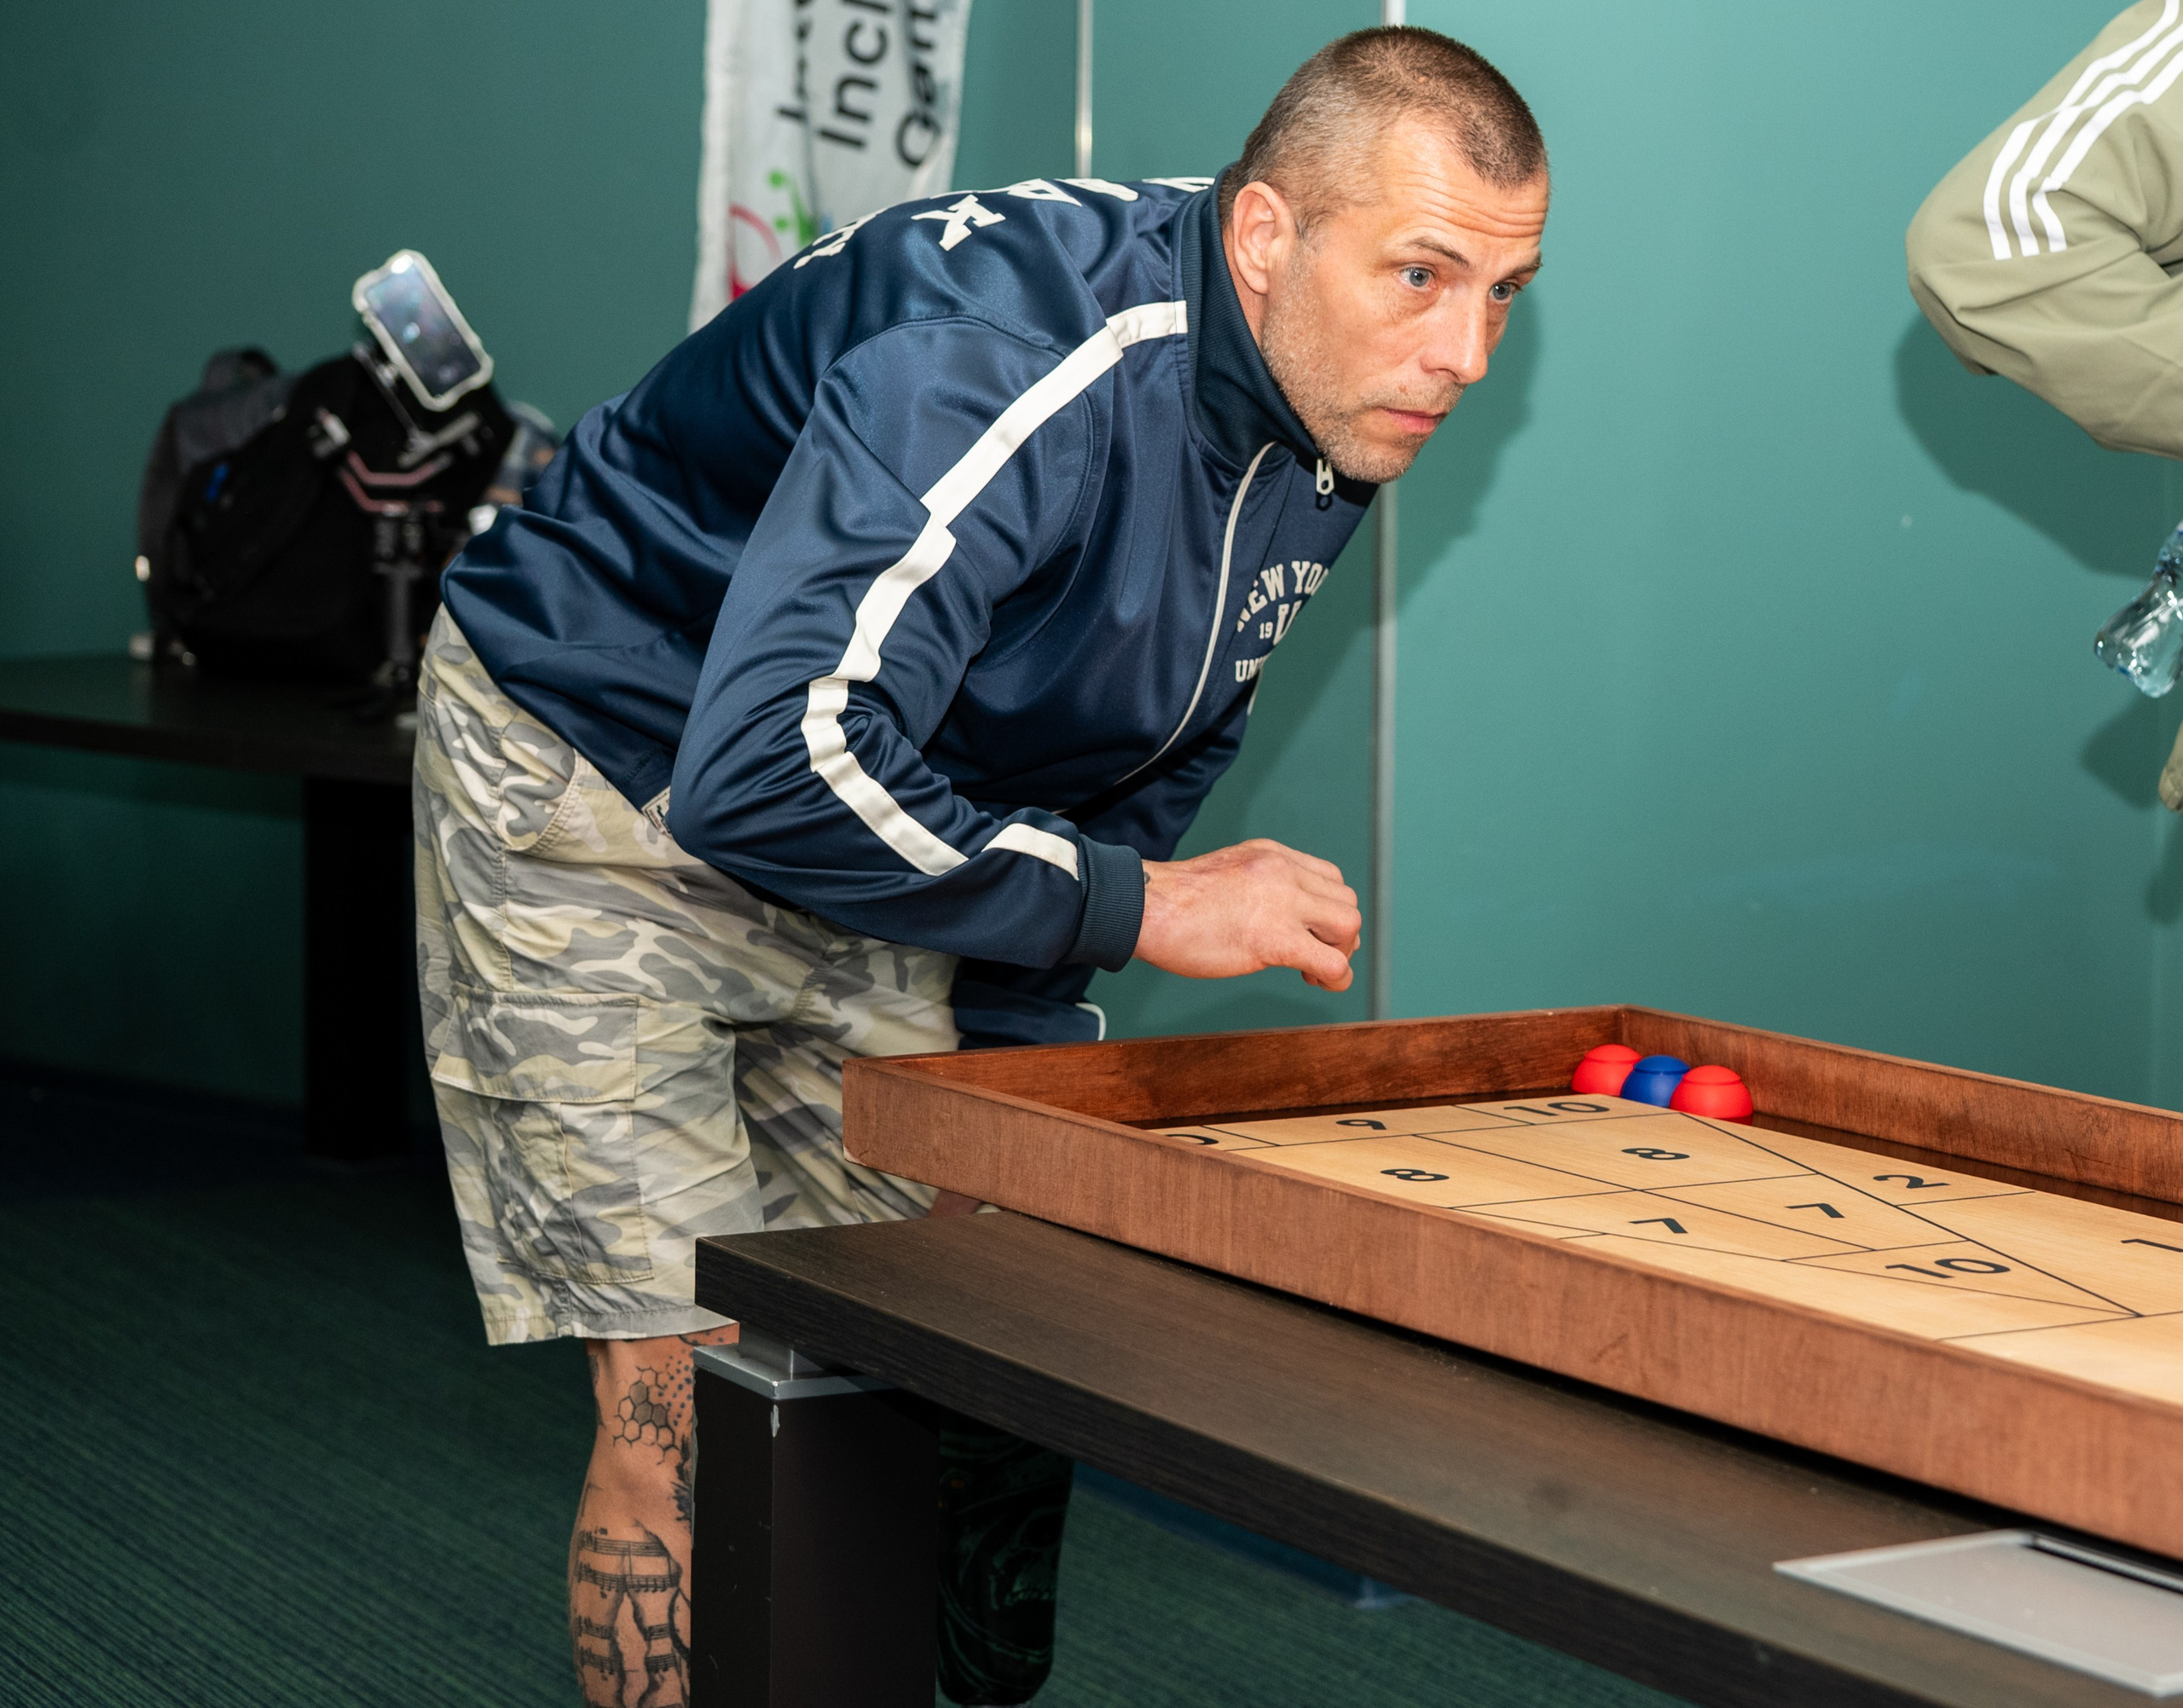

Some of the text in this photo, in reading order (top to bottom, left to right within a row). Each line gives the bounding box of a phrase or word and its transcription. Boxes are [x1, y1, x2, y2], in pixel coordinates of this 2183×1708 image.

[1291, 560, 1329, 596] YO
[1259, 622, 1274, 640] 19
[1503, 1102, 1611, 1117] 10
[1335, 1119, 1387, 1131] 9
[1621, 1147, 1690, 1161] 8
[1380, 1168, 1450, 1182] 8
[1873, 1174, 1951, 1189] 2
[1783, 1202, 1845, 1219] 7
[1627, 1217, 1689, 1235] 7
[1885, 1258, 2012, 1279] 10
